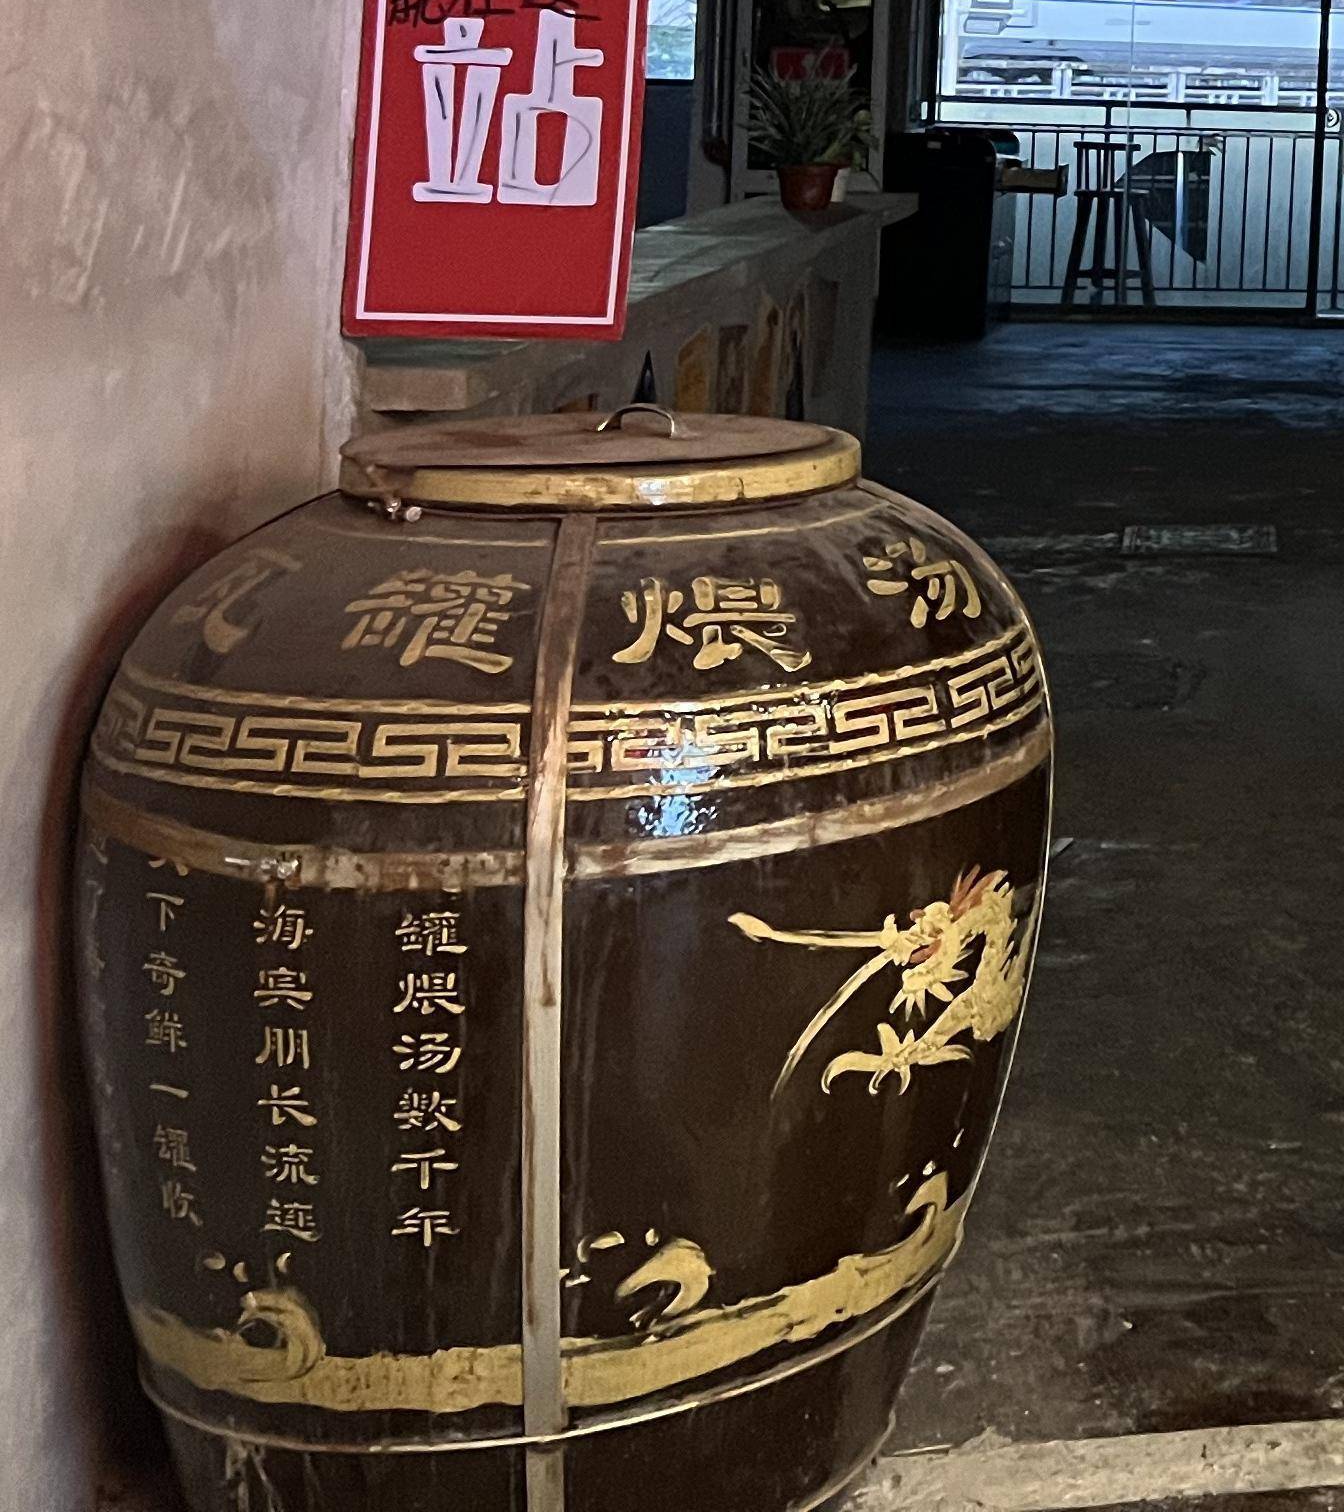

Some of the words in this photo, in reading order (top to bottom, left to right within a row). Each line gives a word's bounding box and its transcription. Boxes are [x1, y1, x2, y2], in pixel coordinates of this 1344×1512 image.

[391, 888, 470, 1248] 罐煨汤数千年
